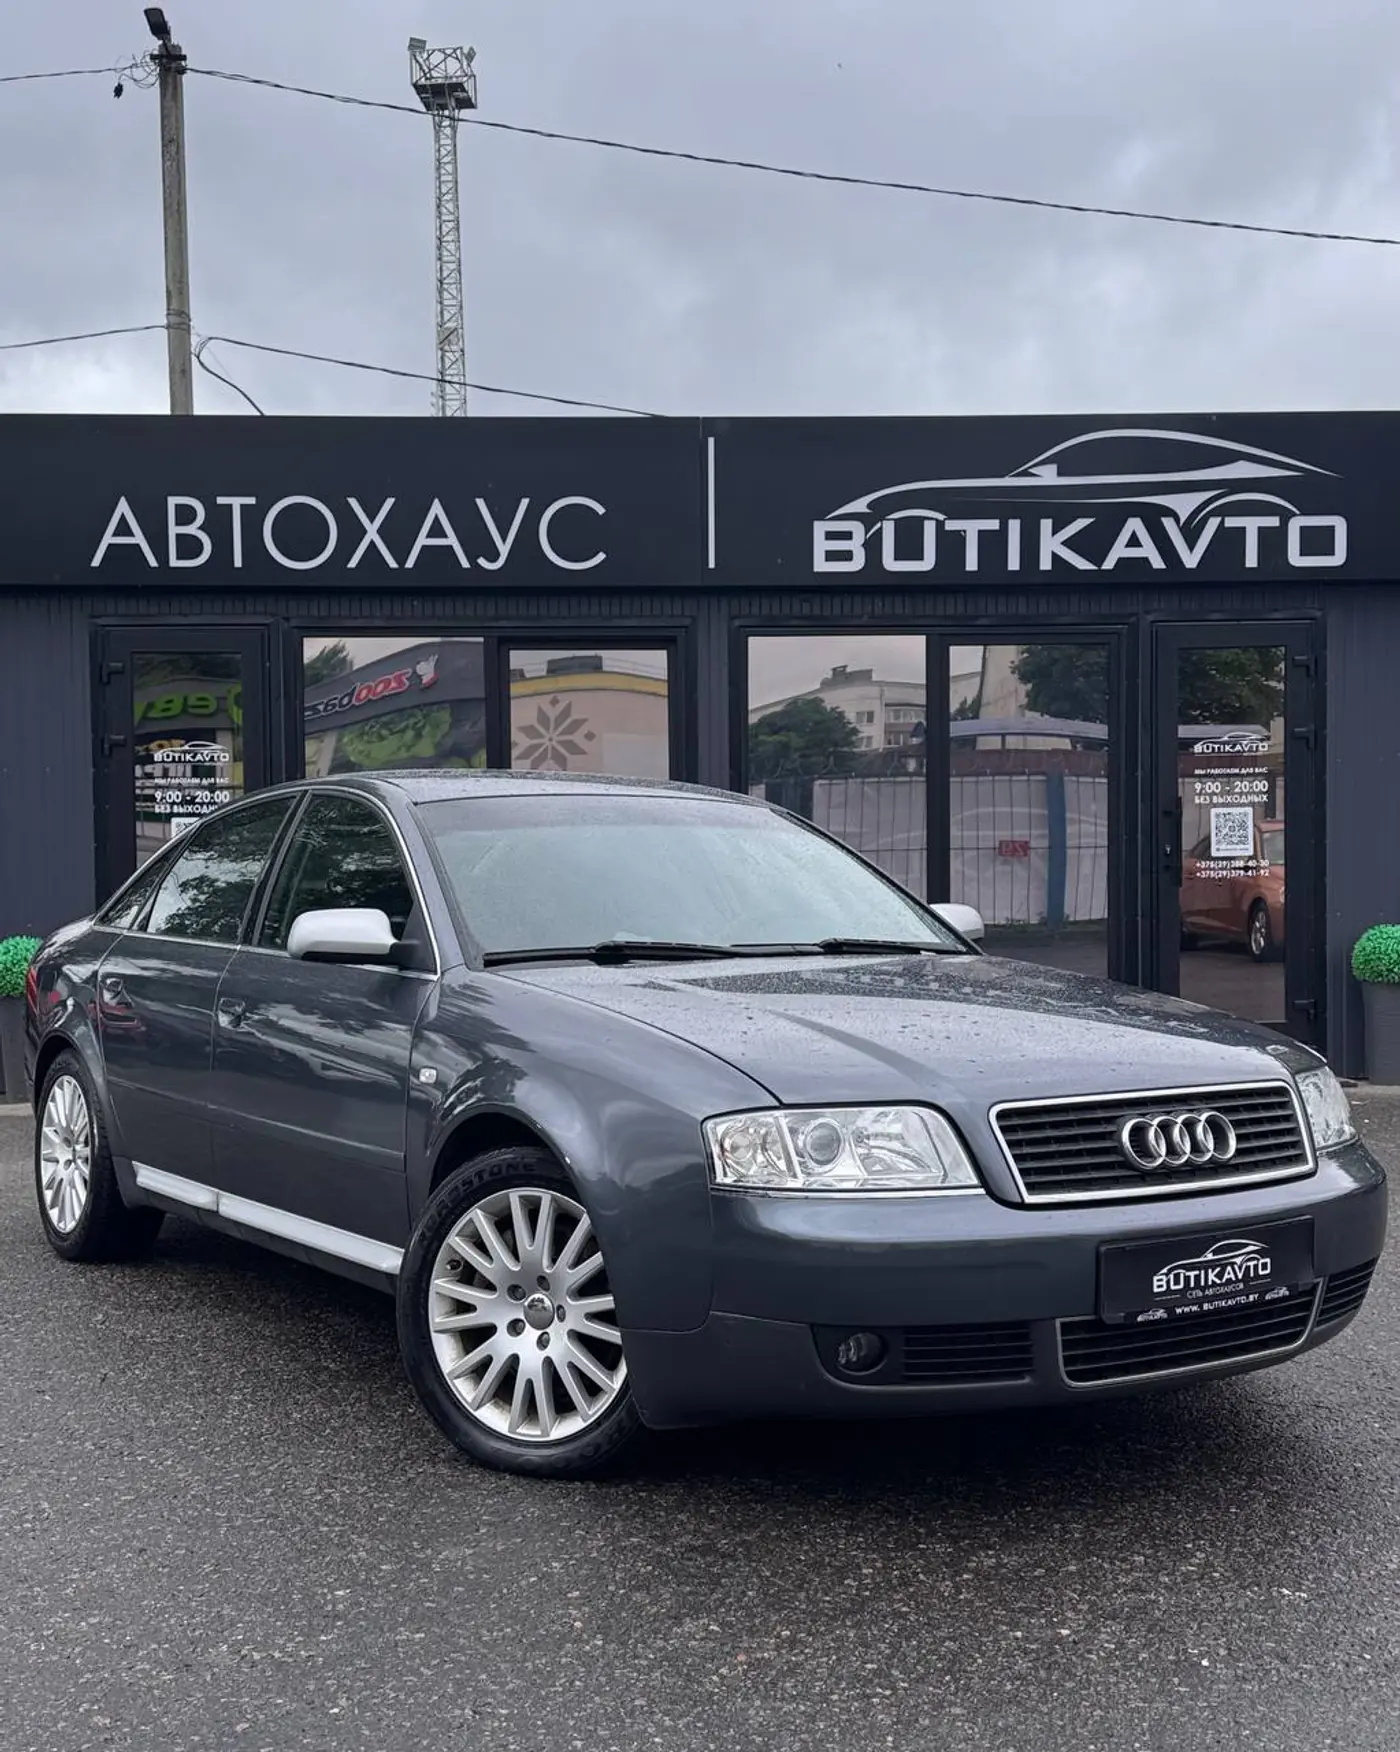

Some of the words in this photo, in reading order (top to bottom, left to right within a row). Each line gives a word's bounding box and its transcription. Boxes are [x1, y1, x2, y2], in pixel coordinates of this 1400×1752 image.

[90, 495, 608, 571] АВТОХАУС
[812, 513, 1348, 573] BUTIKAVTO
[1194, 742, 1268, 753] BUTIKAVTO
[153, 751, 230, 762] BUTIKAVTO
[1194, 781, 1221, 793] 9:00
[1234, 780, 1269, 792] 20:00
[154, 791, 182, 802] 9:00
[195, 790, 230, 802] 20:00
[1194, 795, 1210, 804] БЕЗ
[1212, 794, 1269, 803] ВЫХОДНЫХ
[154, 804, 171, 813] БЕЗ
[1153, 1257, 1271, 1293] BUTIKAVTO
[1203, 1292, 1259, 1311] BUTIKAVTO.BY
